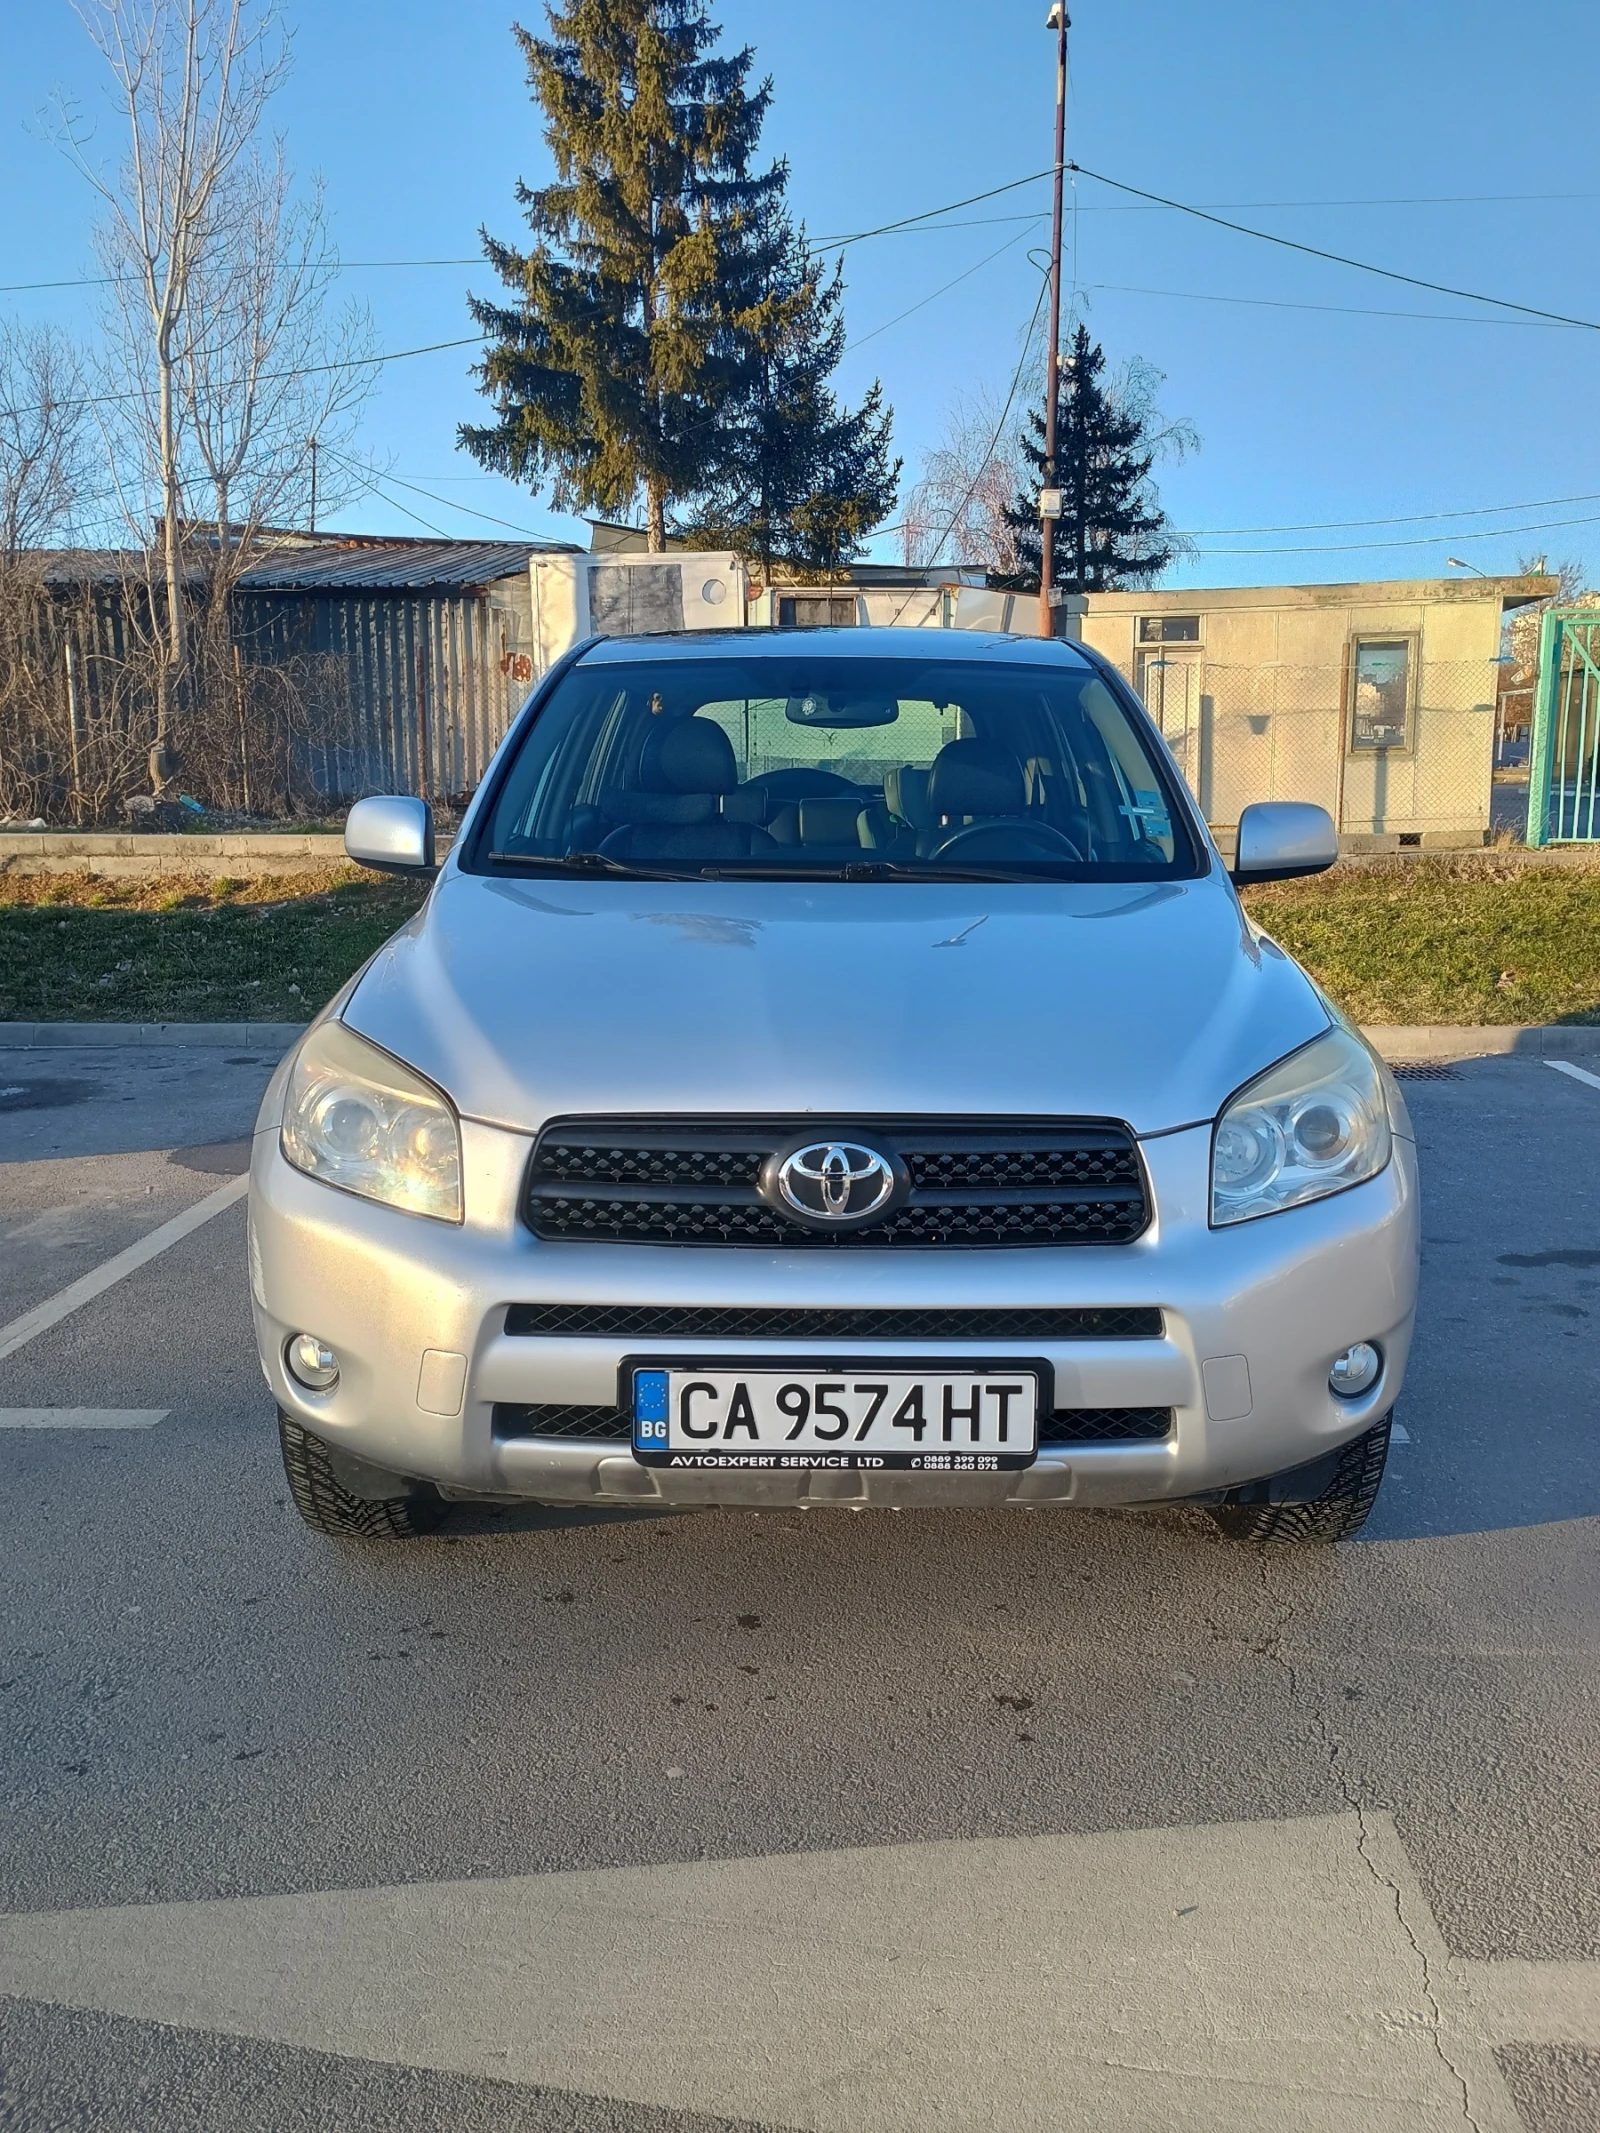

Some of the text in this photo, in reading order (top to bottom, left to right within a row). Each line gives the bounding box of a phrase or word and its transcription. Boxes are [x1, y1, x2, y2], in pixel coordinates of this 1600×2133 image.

[680, 1381, 1023, 1442] CA 9574 HT
[641, 1420, 667, 1438] BG
[670, 1456, 885, 1467] AVTOEXPERT SERVICE LTD
[924, 1455, 951, 1463] 0889
[954, 1455, 974, 1463] 399
[924, 1462, 951, 1470] 0888
[954, 1462, 974, 1470] 660
